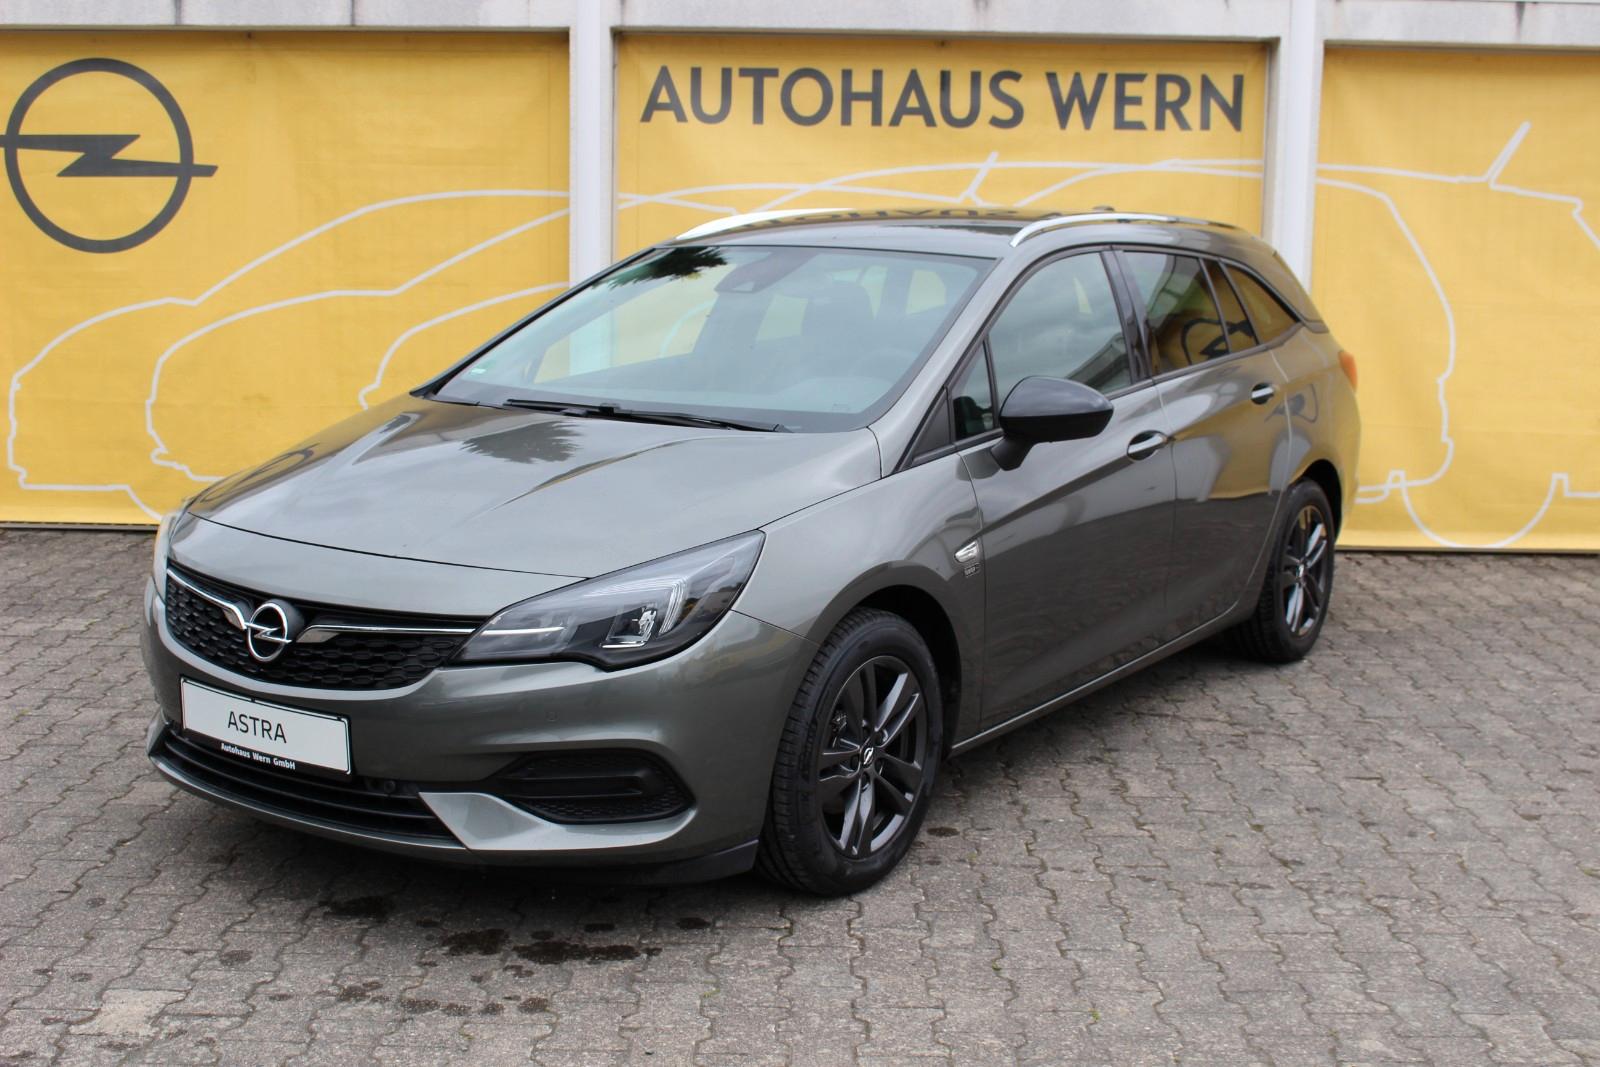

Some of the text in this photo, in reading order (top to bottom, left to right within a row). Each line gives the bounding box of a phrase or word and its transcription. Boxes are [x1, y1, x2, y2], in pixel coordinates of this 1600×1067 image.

[640, 65, 1244, 132] AUTOHAUS WERN
[227, 711, 287, 743] ASTRA
[221, 742, 296, 770] Autohaus Wern GmbH
